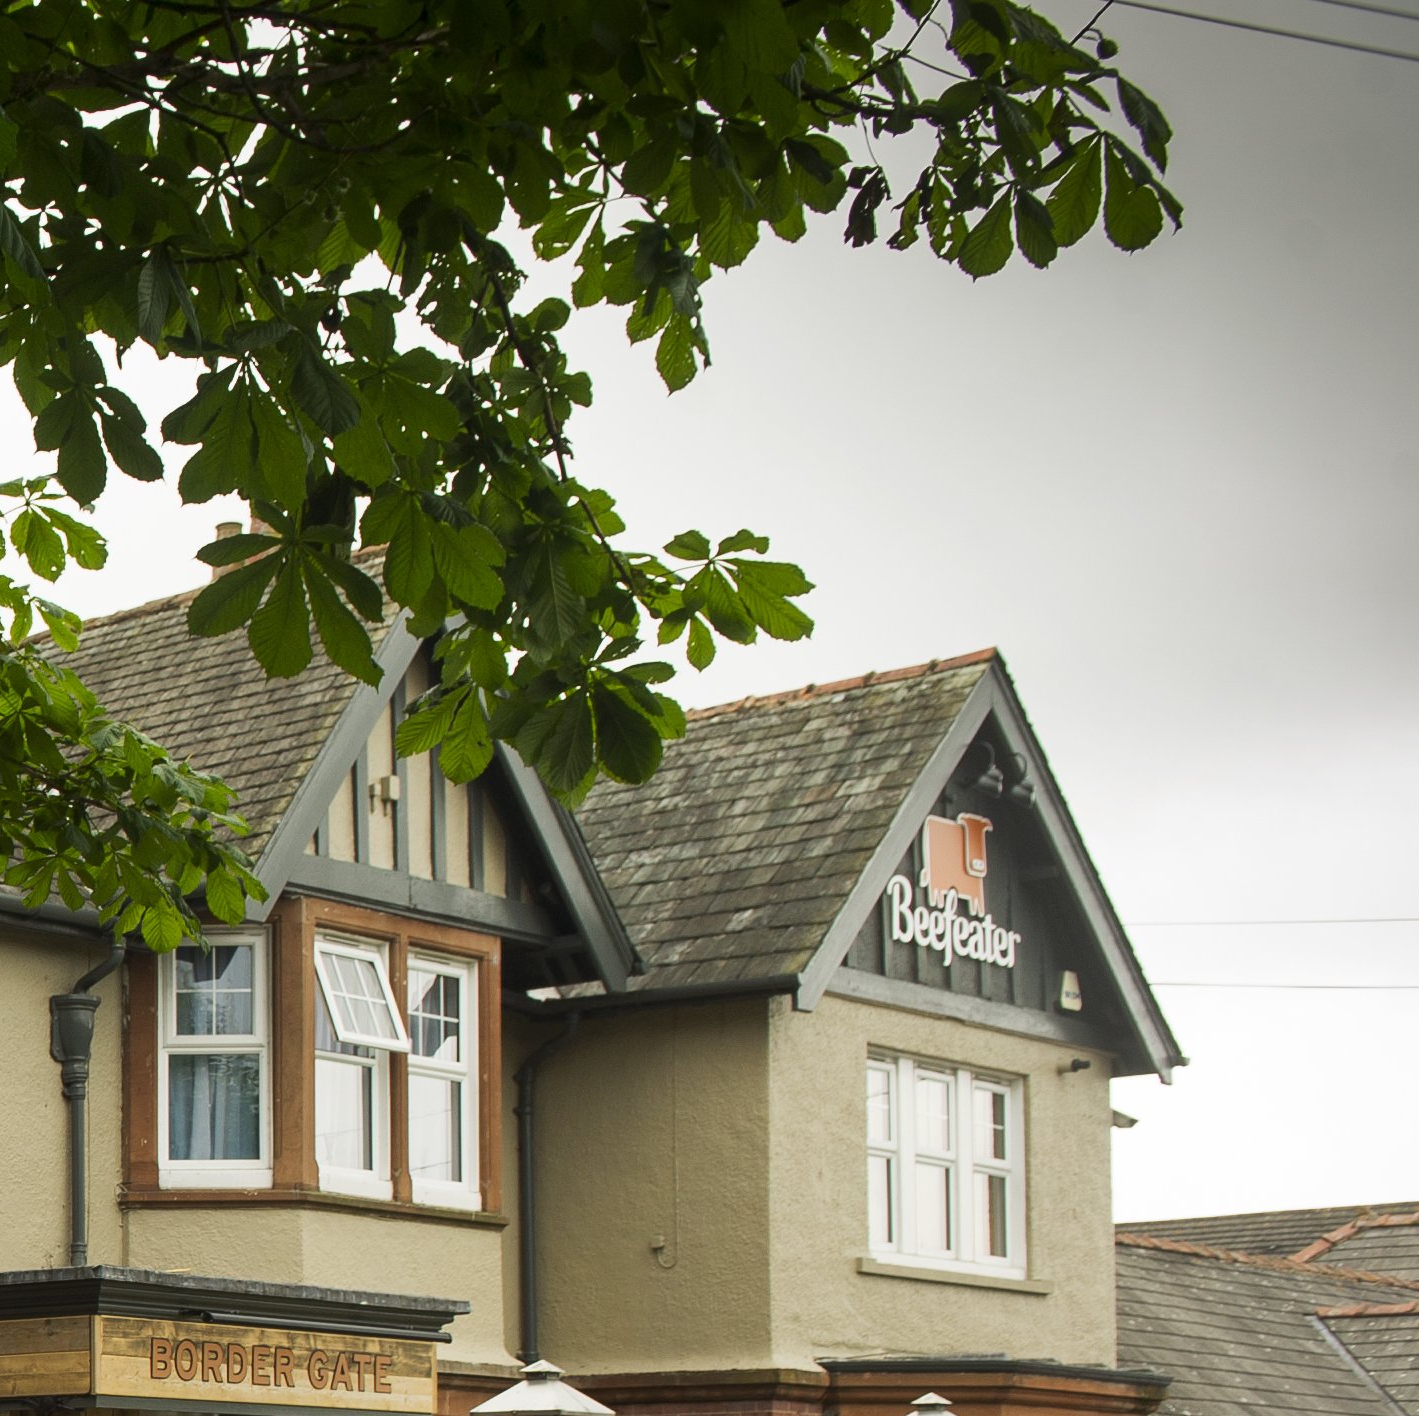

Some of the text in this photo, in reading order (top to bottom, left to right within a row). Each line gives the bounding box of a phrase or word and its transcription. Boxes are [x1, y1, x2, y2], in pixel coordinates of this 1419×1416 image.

[886, 874, 1021, 968] Beefeater
[150, 1336, 392, 1394] BORDER GATE
